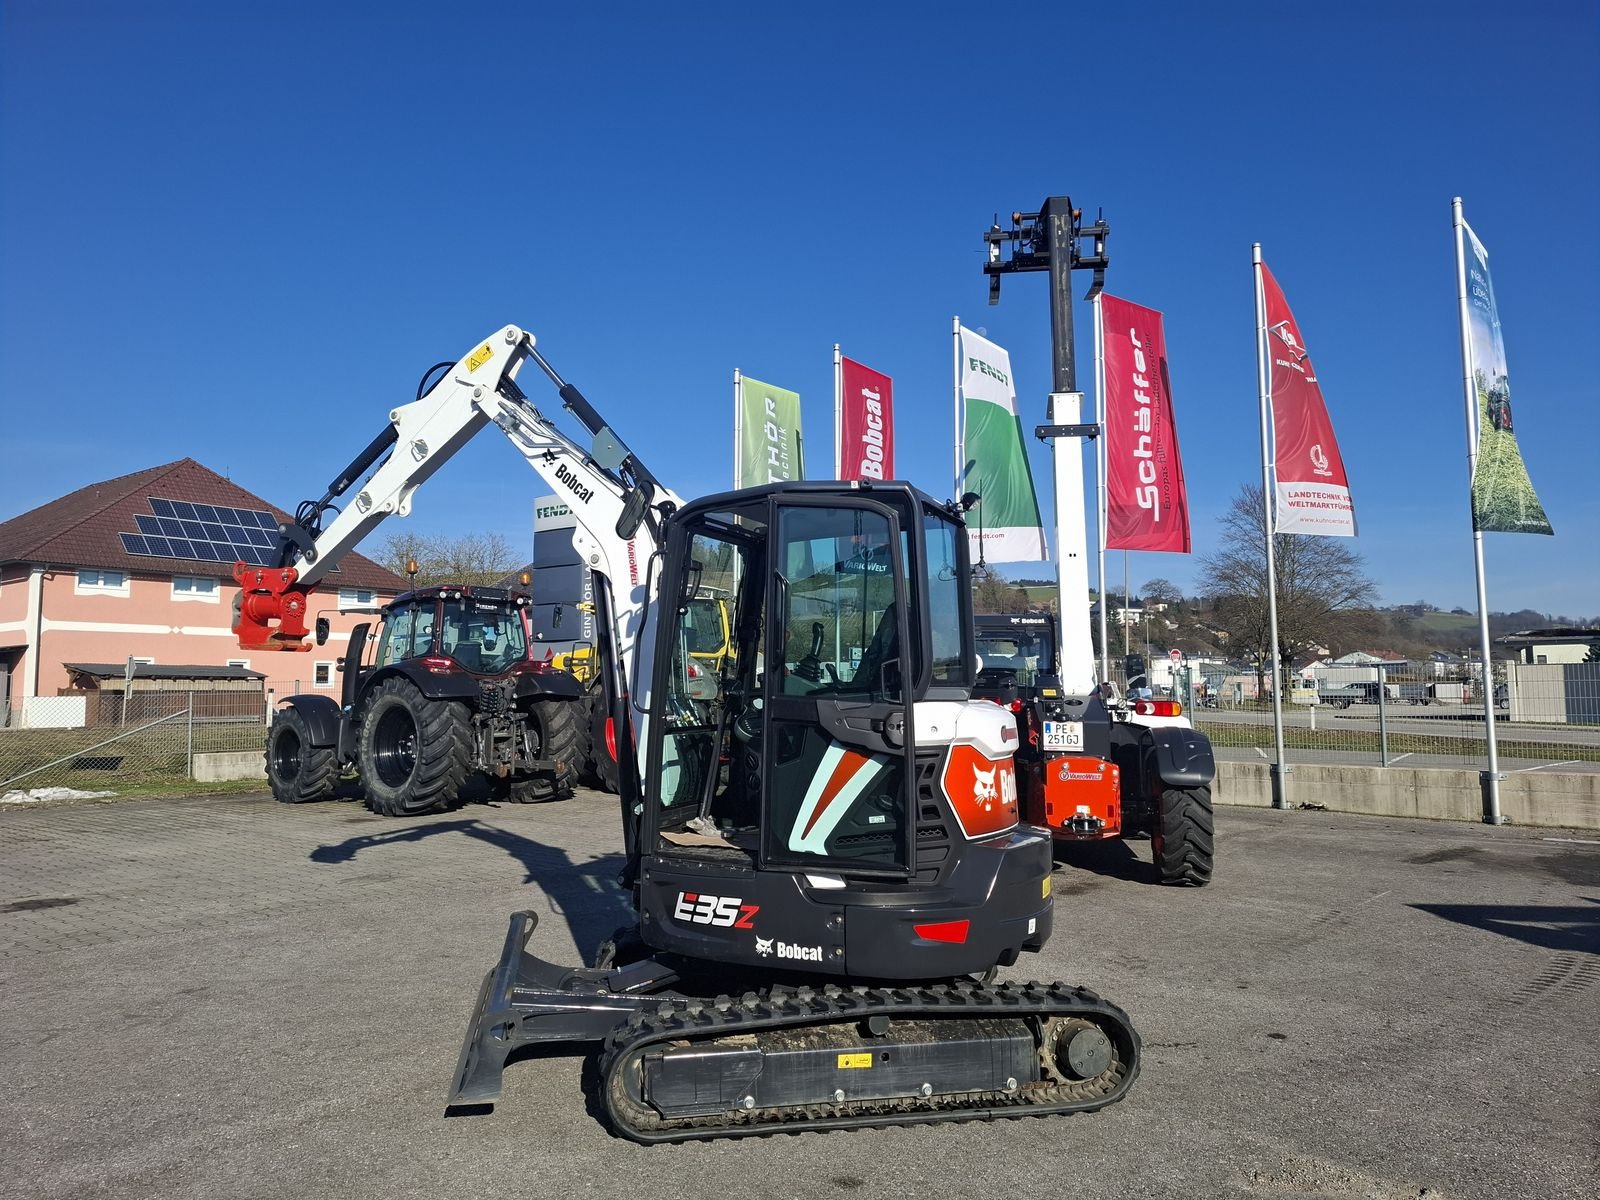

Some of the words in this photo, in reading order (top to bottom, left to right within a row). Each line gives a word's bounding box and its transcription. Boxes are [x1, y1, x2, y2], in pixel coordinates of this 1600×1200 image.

[969, 357, 1009, 388] FENDT
[861, 387, 883, 480] Bobcat
[1130, 327, 1159, 522] Schäffer
[1154, 412, 1166, 464] führeder
[555, 463, 595, 505] Bobcat
[1163, 466, 1171, 510] Europas
[1288, 491, 1341, 501] LANDTECHNIK
[1047, 734, 1079, 745] 251GJ
[1055, 724, 1068, 734] PE
[777, 941, 823, 962] Bobcat
